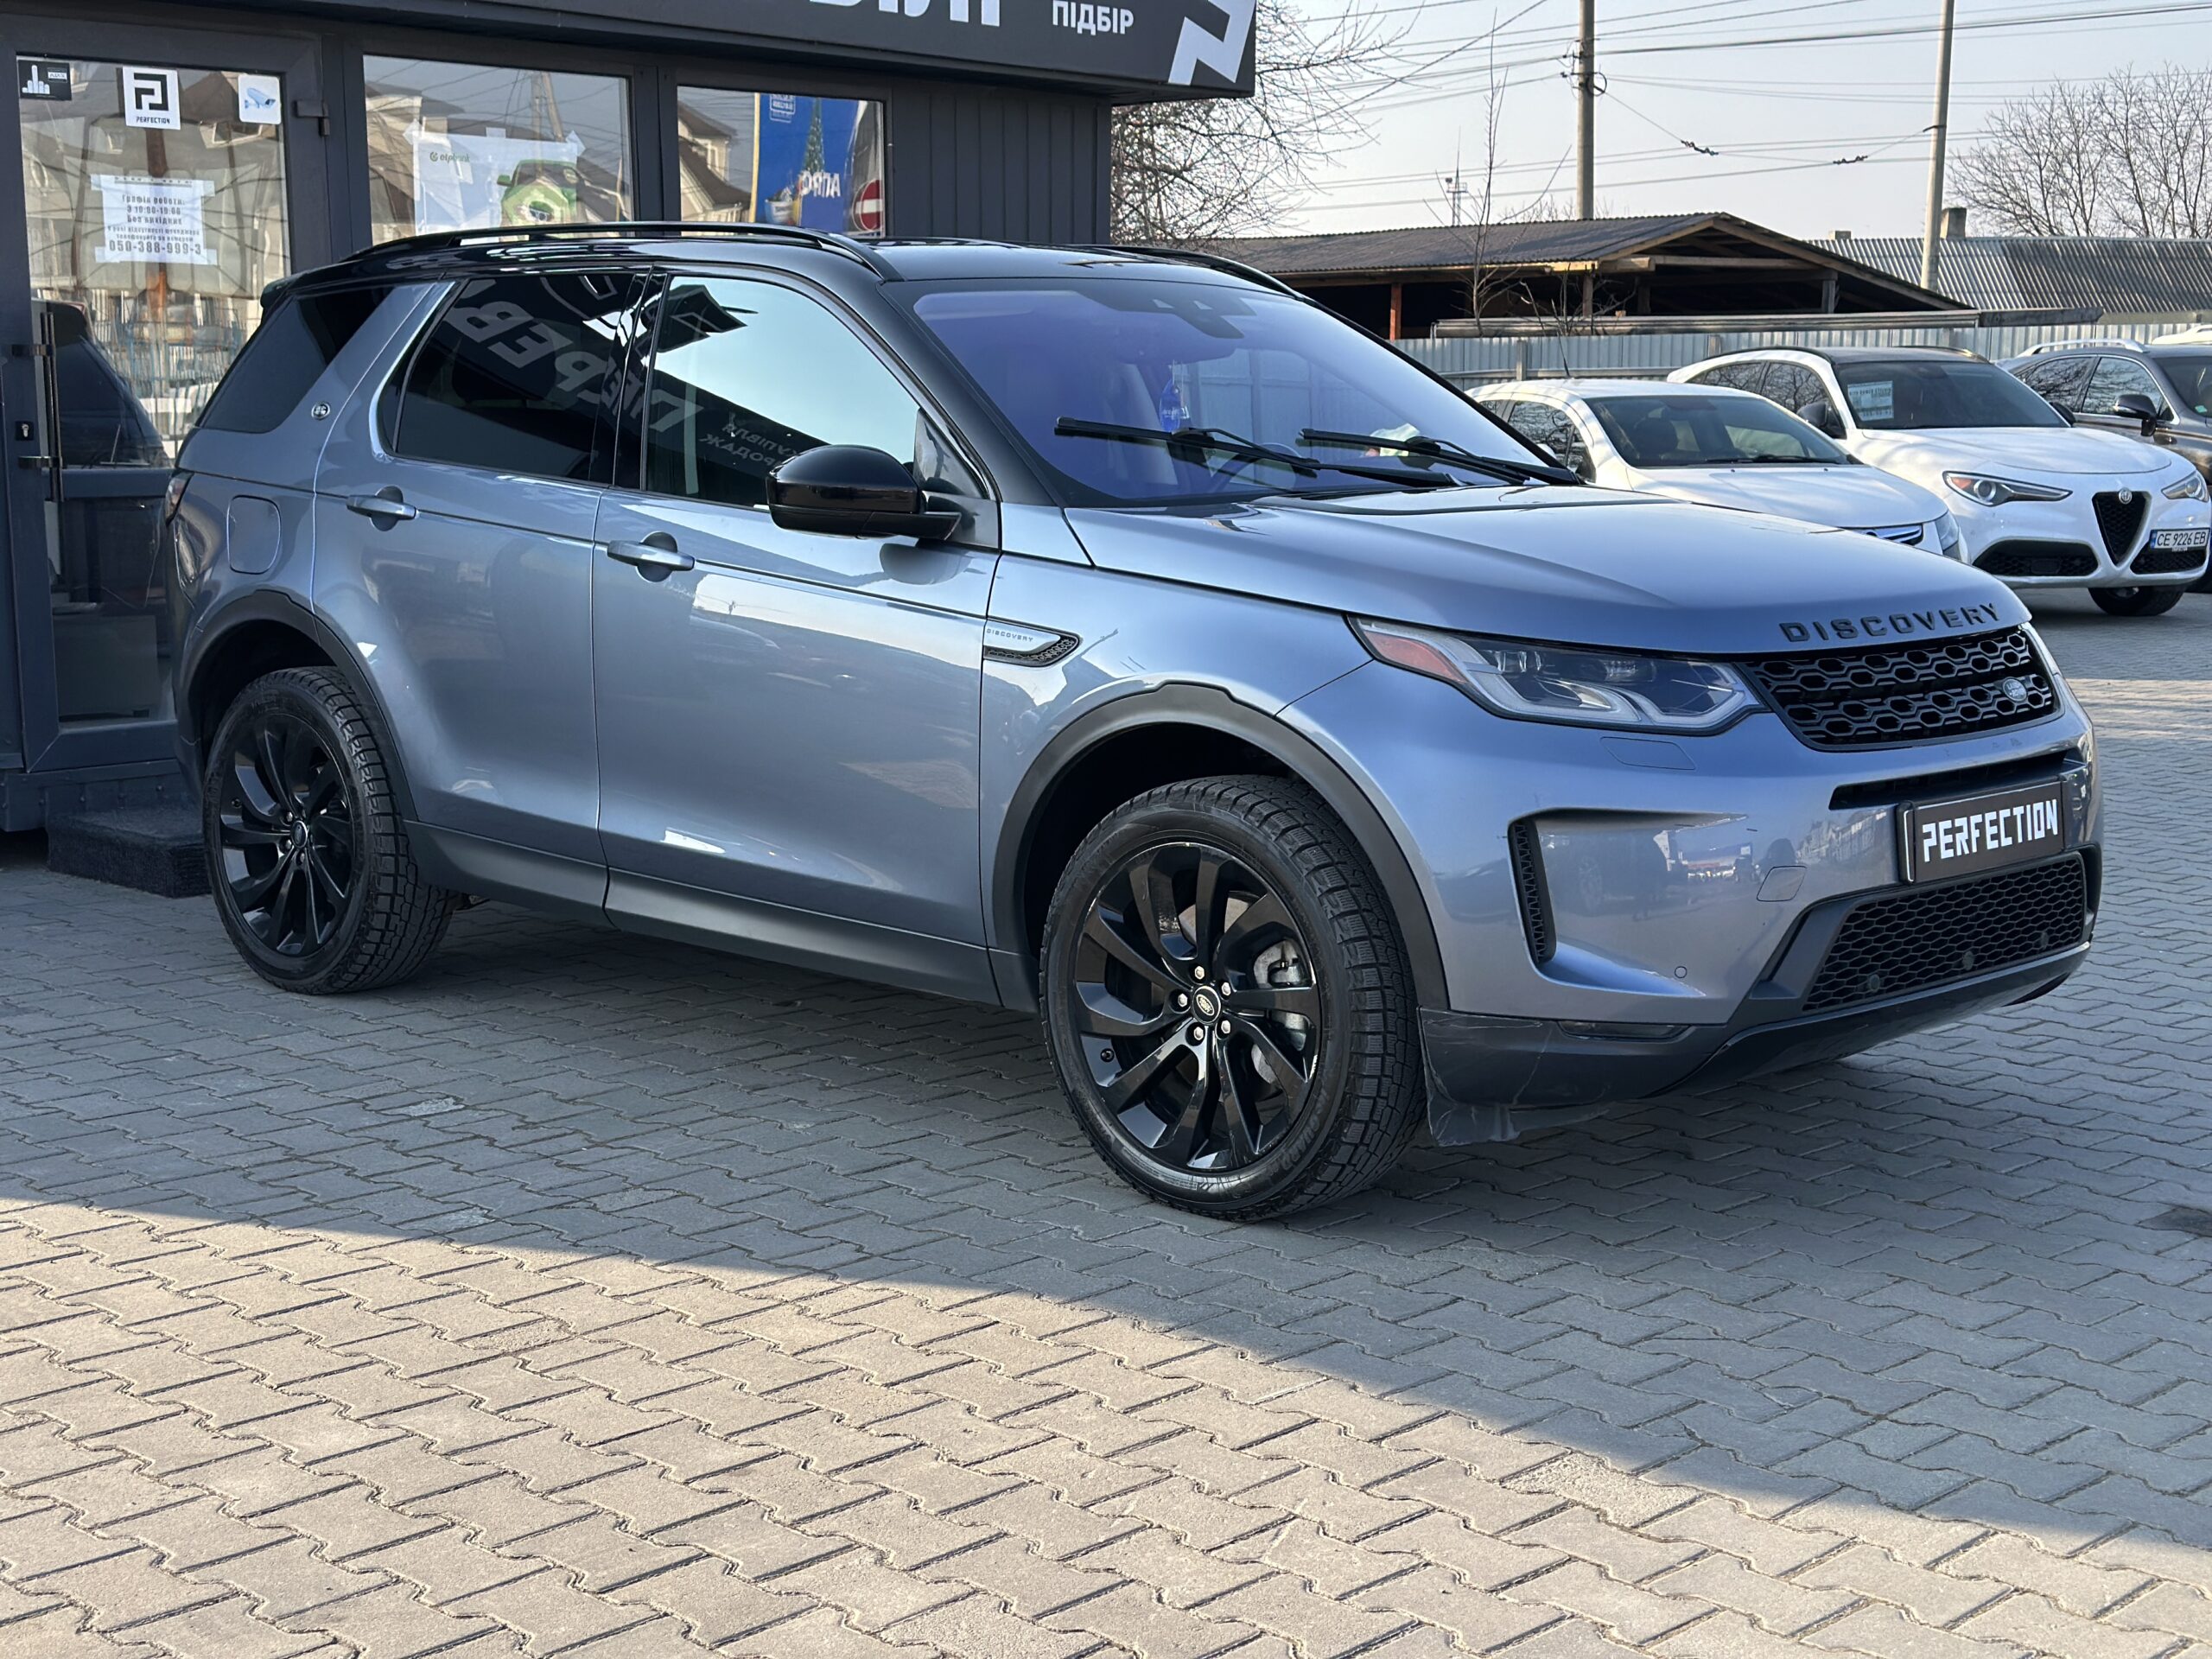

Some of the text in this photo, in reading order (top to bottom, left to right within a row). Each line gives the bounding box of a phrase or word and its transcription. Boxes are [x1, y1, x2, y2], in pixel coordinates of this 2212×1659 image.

[1051, 0, 1135, 35] ПІДБІР
[136, 115, 170, 124] PERFECTION
[109, 239, 201, 255] 050-388-999-3
[2157, 531, 2207, 546] CE 9226 EB
[1778, 602, 2001, 643] DISCOVERY
[987, 628, 1033, 642] DISCOVERY
[1922, 798, 2058, 862] PERFECTION
